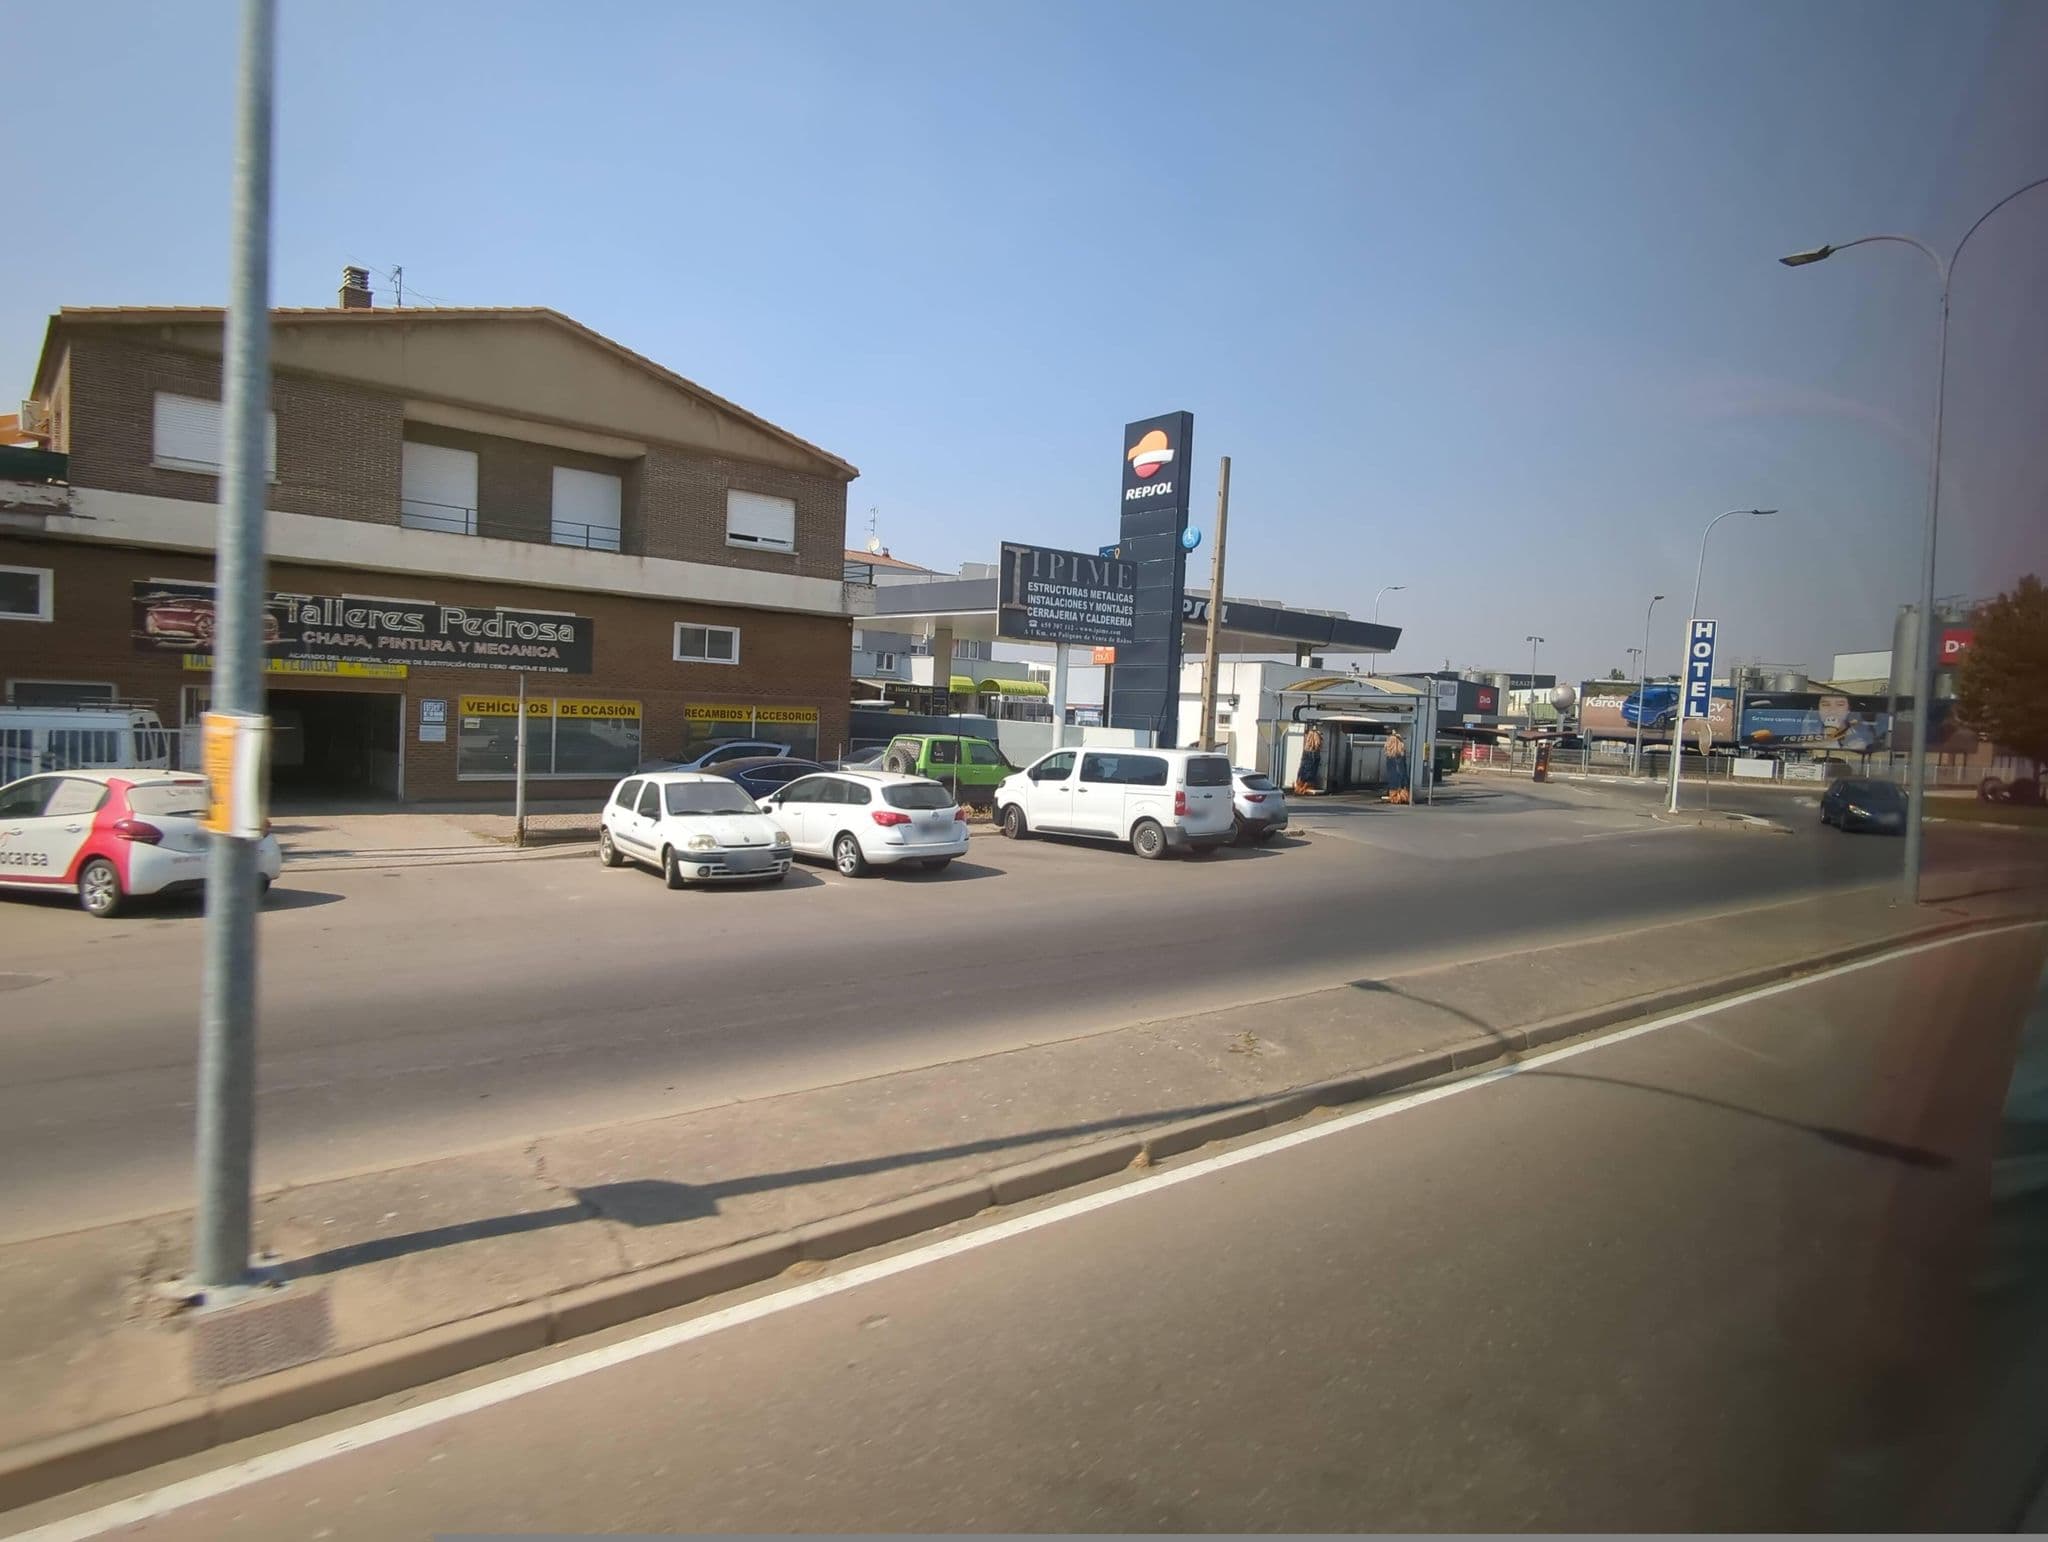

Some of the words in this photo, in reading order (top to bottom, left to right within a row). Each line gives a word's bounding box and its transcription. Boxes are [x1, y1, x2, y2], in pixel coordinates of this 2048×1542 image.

[1125, 481, 1173, 500] REPSOL
[1027, 581, 1088, 598] ESTRUCTURAS
[1089, 590, 1134, 604] METALICAS
[1027, 594, 1088, 610] INSTALACIONES
[1089, 602, 1095, 611] Y
[1096, 602, 1133, 615] MONTAJES
[275, 594, 425, 632] Talleres
[440, 607, 575, 642] Pedrosa
[1026, 606, 1078, 621] CERRAJERIA
[1079, 612, 1085, 621] Y
[1086, 614, 1133, 627] CALDERERIA
[301, 631, 373, 649] CHAPA,
[377, 636, 456, 653] PINTURA
[458, 641, 471, 653] Y
[474, 642, 560, 659] MECANICA
[1690, 622, 1713, 717] HOTEL
[466, 701, 548, 714] VEHICUOS
[561, 705, 577, 714] DE
[581, 704, 636, 716] OCASIÓN
[684, 708, 743, 719] RECAMBIOS
[745, 711, 752, 720] Y
[755, 711, 818, 721] ACCESORIOS
[1586, 697, 1625, 711] Karoq
